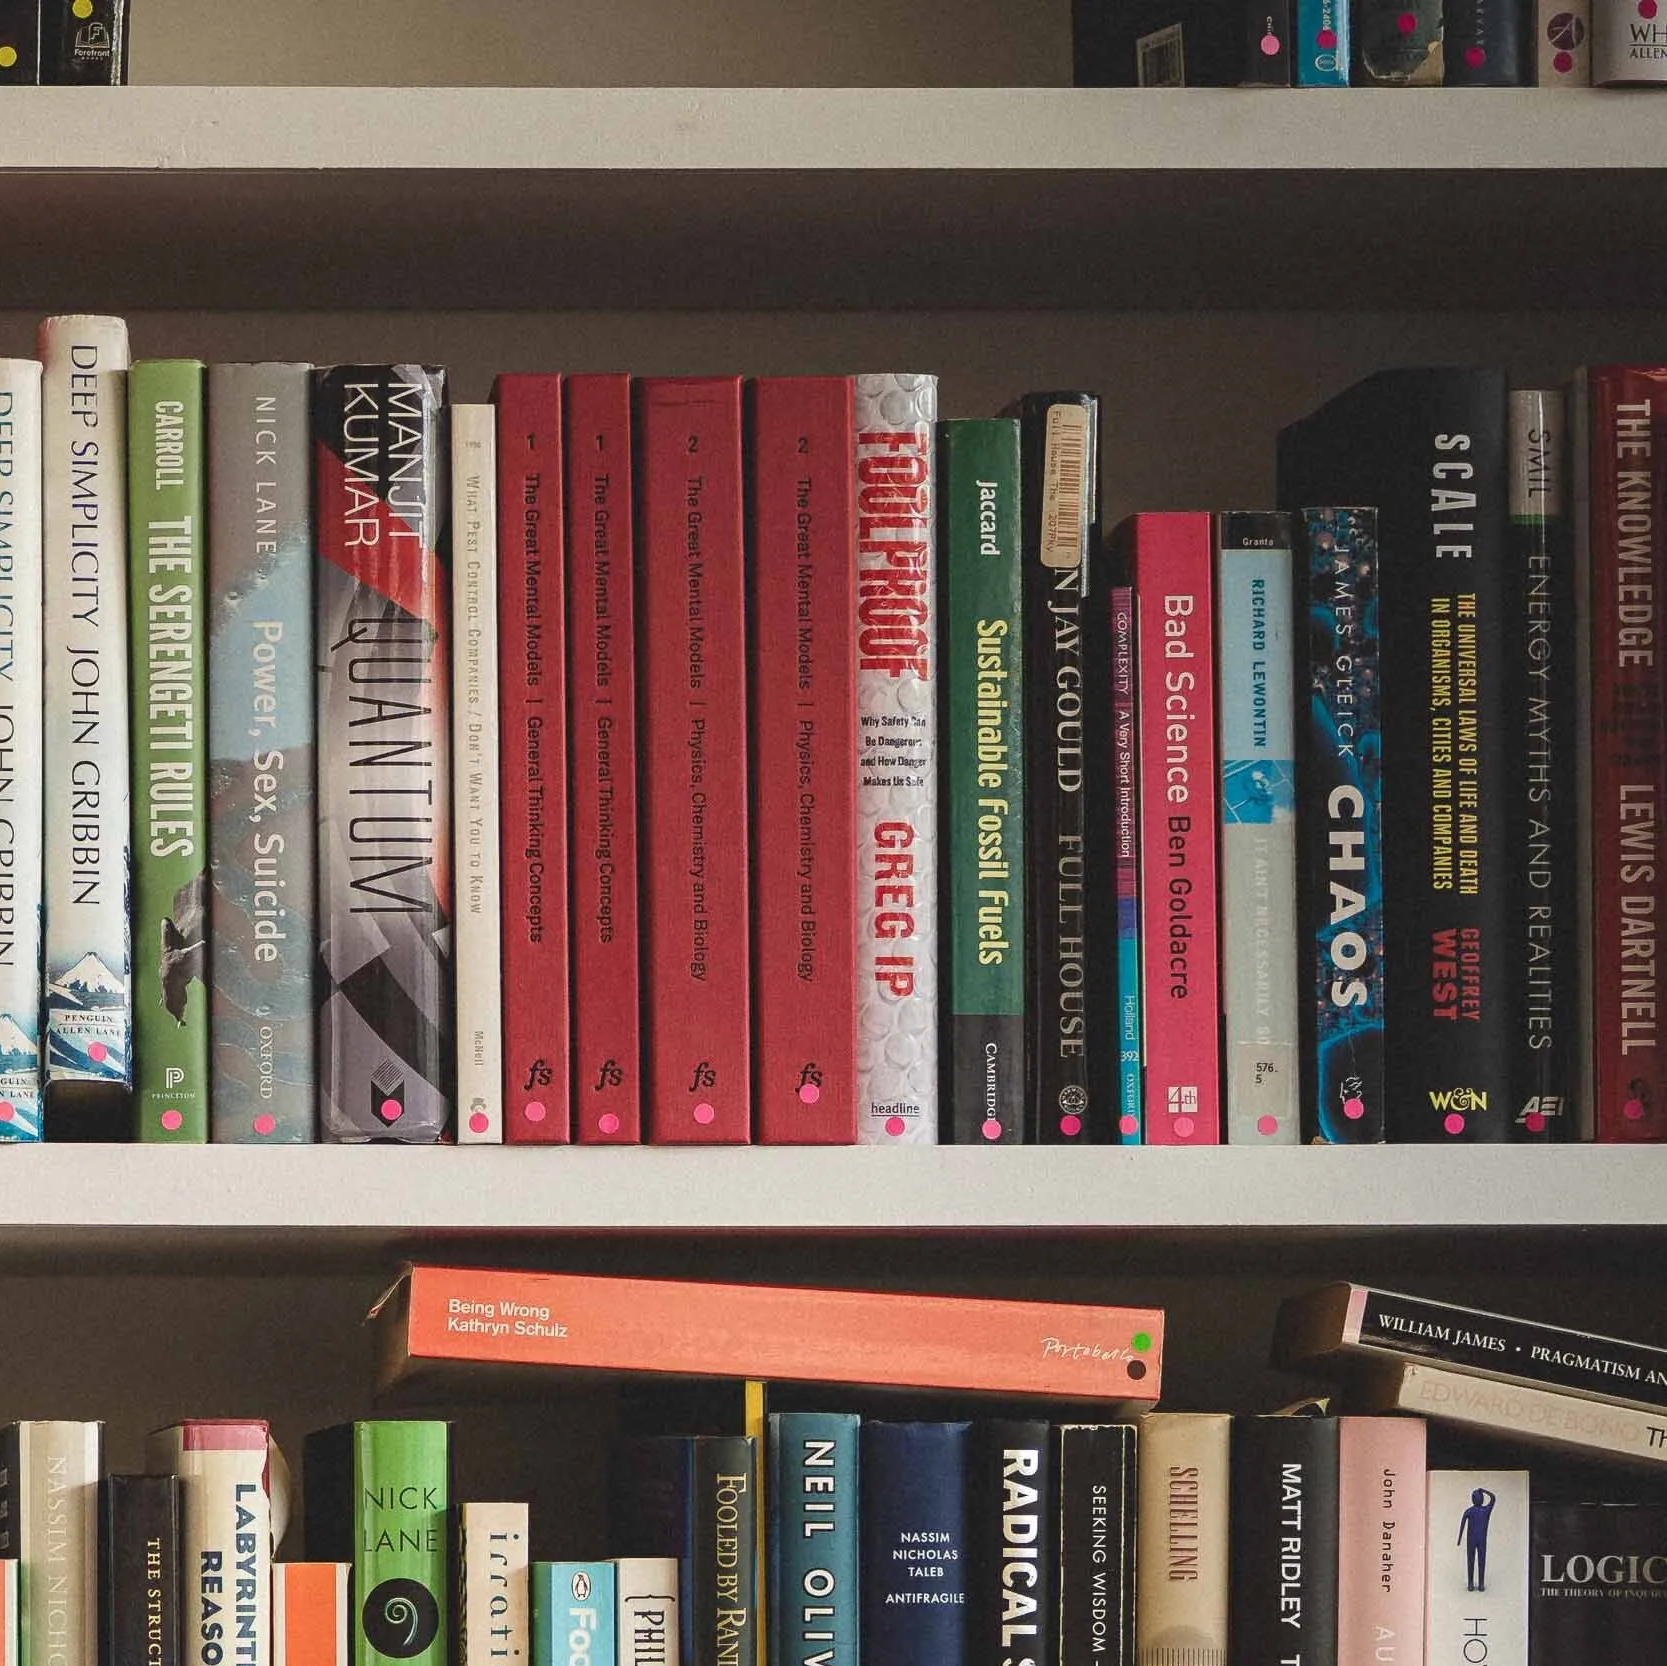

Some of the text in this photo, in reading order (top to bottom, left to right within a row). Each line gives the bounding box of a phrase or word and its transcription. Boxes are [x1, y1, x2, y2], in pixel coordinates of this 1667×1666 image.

[976, 480, 1000, 555] Jaccard
[1431, 434, 1476, 558] SCALE
[148, 516, 194, 857] THE SERENGETI RULES
[977, 620, 1009, 964] Sustainable Fossil Fuels
[1328, 785, 1367, 1007] CHAOS
[871, 1100, 919, 1118] headline
[448, 1317, 568, 1337] Kathryn Schulz
[449, 1298, 550, 1320] Being Wrong
[365, 1485, 441, 1512] NICK
[802, 1440, 834, 1538] NEIL
[364, 1526, 440, 1554] LANE
[1002, 1450, 1039, 1646] RADICAL
